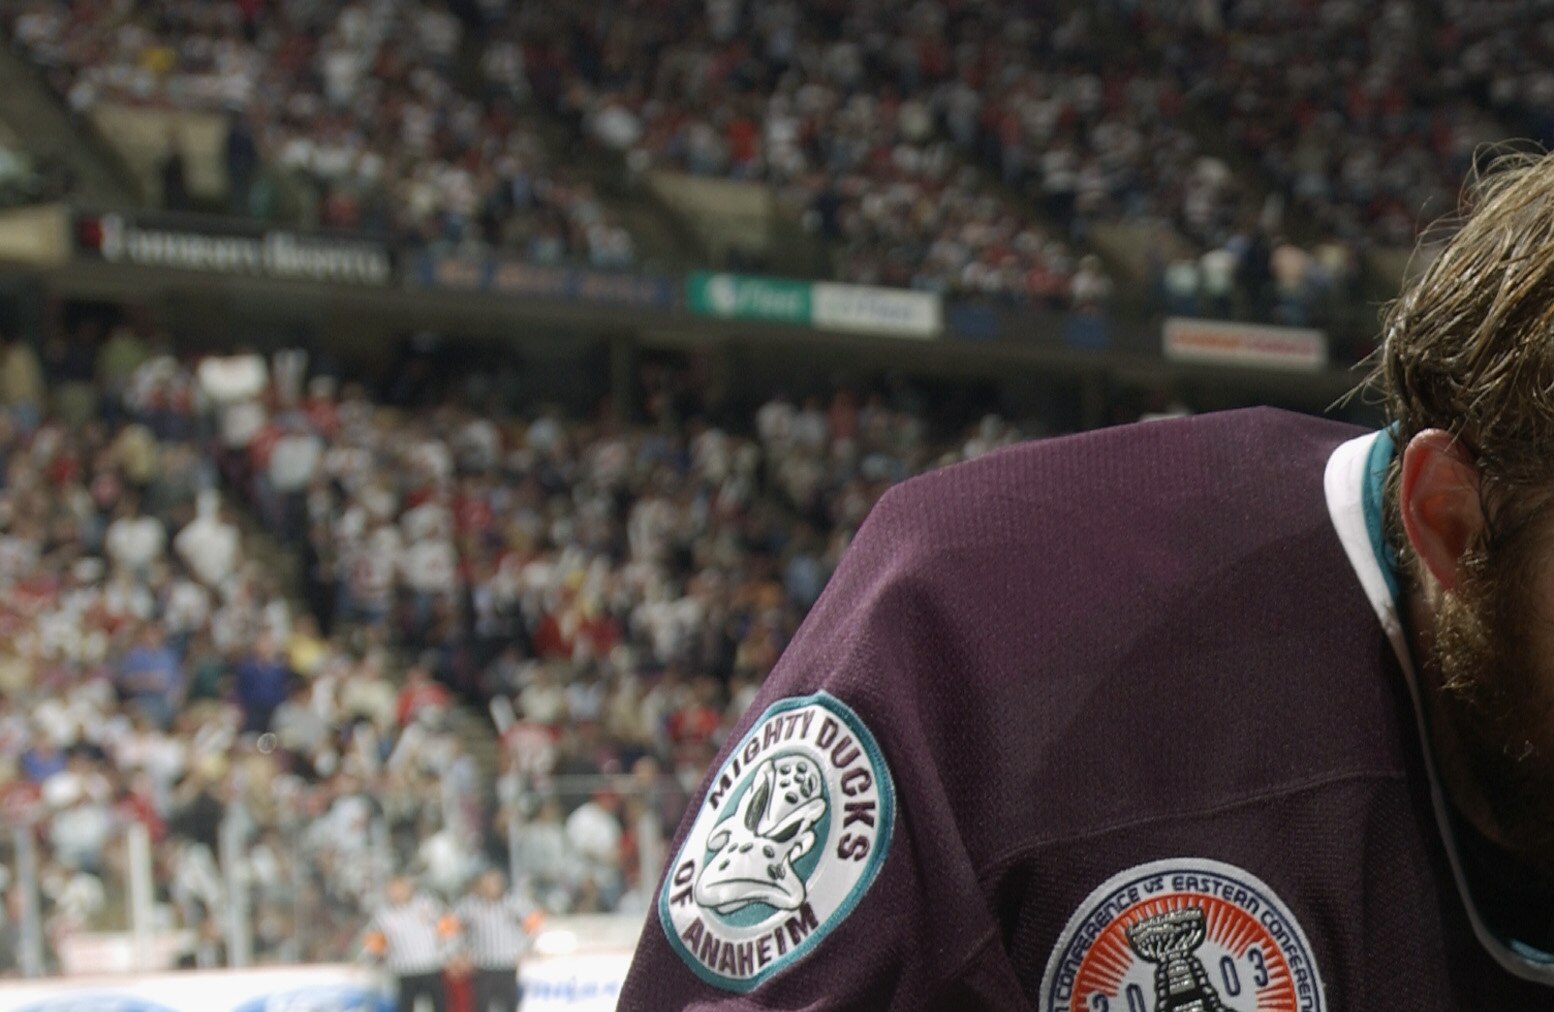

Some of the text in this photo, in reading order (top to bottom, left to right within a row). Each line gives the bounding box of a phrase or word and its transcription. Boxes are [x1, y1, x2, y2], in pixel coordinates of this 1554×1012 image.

[707, 708, 877, 863] MIGHTY DUCKS
[671, 859, 819, 977] OF ANAHEIM
[1055, 886, 1141, 1003] CONFERENCE
[1171, 875, 1260, 914] EASTERN
